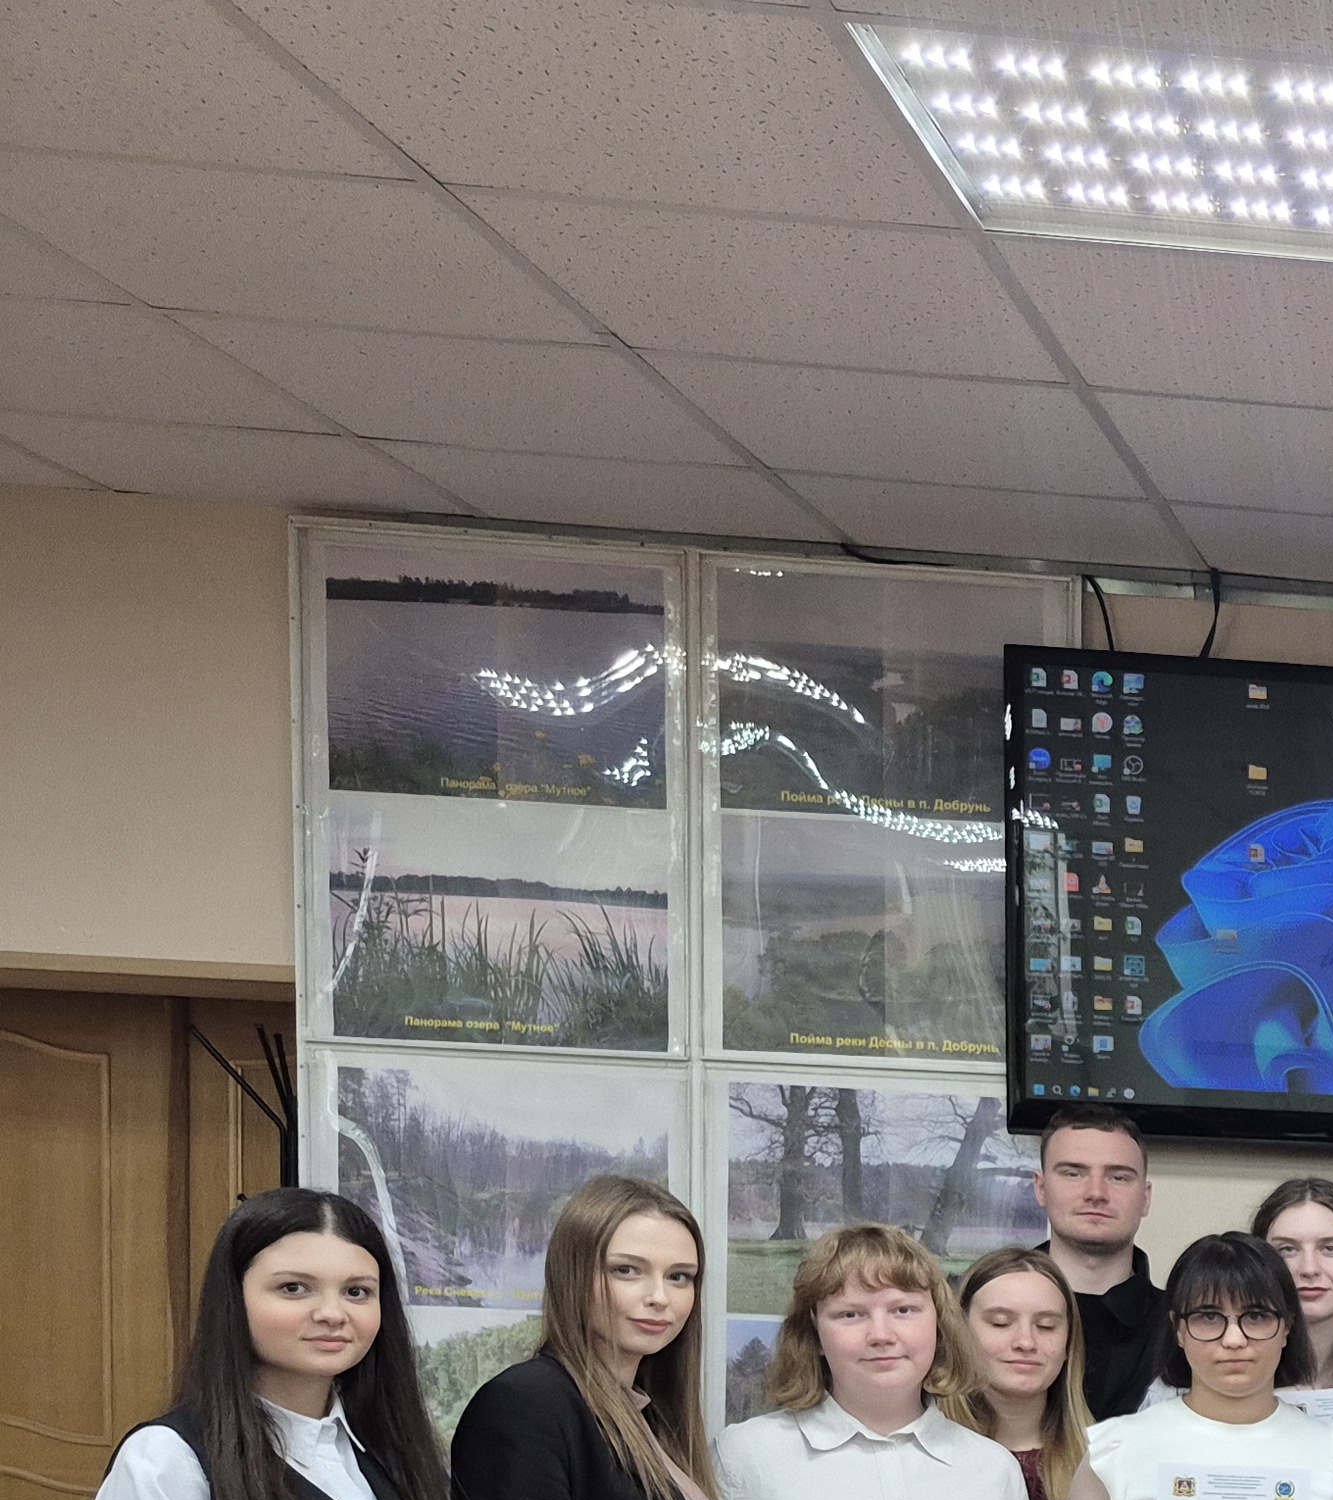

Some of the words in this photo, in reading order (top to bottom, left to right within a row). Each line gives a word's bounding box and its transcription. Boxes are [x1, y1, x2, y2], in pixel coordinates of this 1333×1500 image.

[781, 790, 823, 804] Пойма
[933, 799, 991, 814] Добрунь
[404, 1015, 463, 1029] Панорама
[466, 1021, 499, 1032] озера
[790, 1032, 832, 1045] Пойма
[836, 1036, 866, 1047] реки
[868, 1036, 912, 1049] Десны
[927, 1041, 938, 1050] п.
[942, 1039, 1000, 1054] Добрунь
